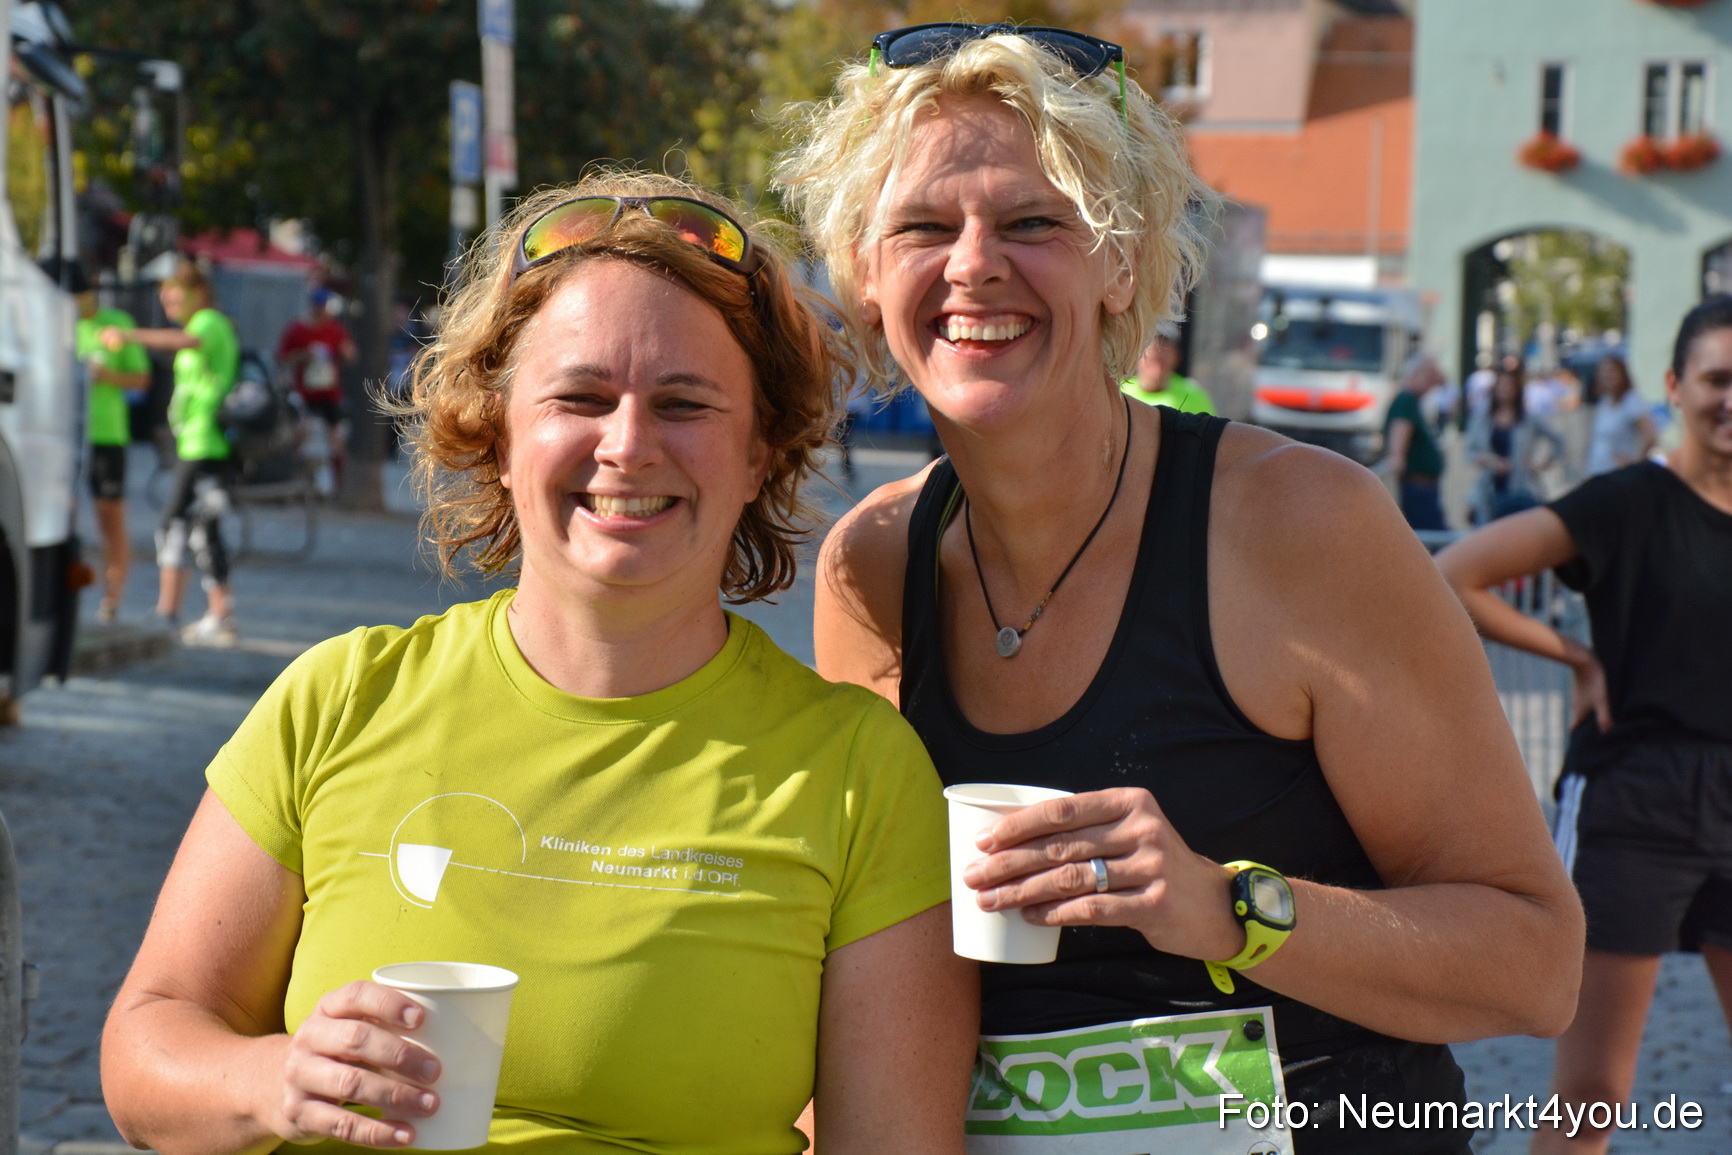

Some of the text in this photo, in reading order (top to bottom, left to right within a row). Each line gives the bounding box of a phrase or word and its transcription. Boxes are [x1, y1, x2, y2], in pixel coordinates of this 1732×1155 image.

[540, 834, 744, 869] Kliniken des Landkreises
[591, 860, 678, 879] Neumarkt
